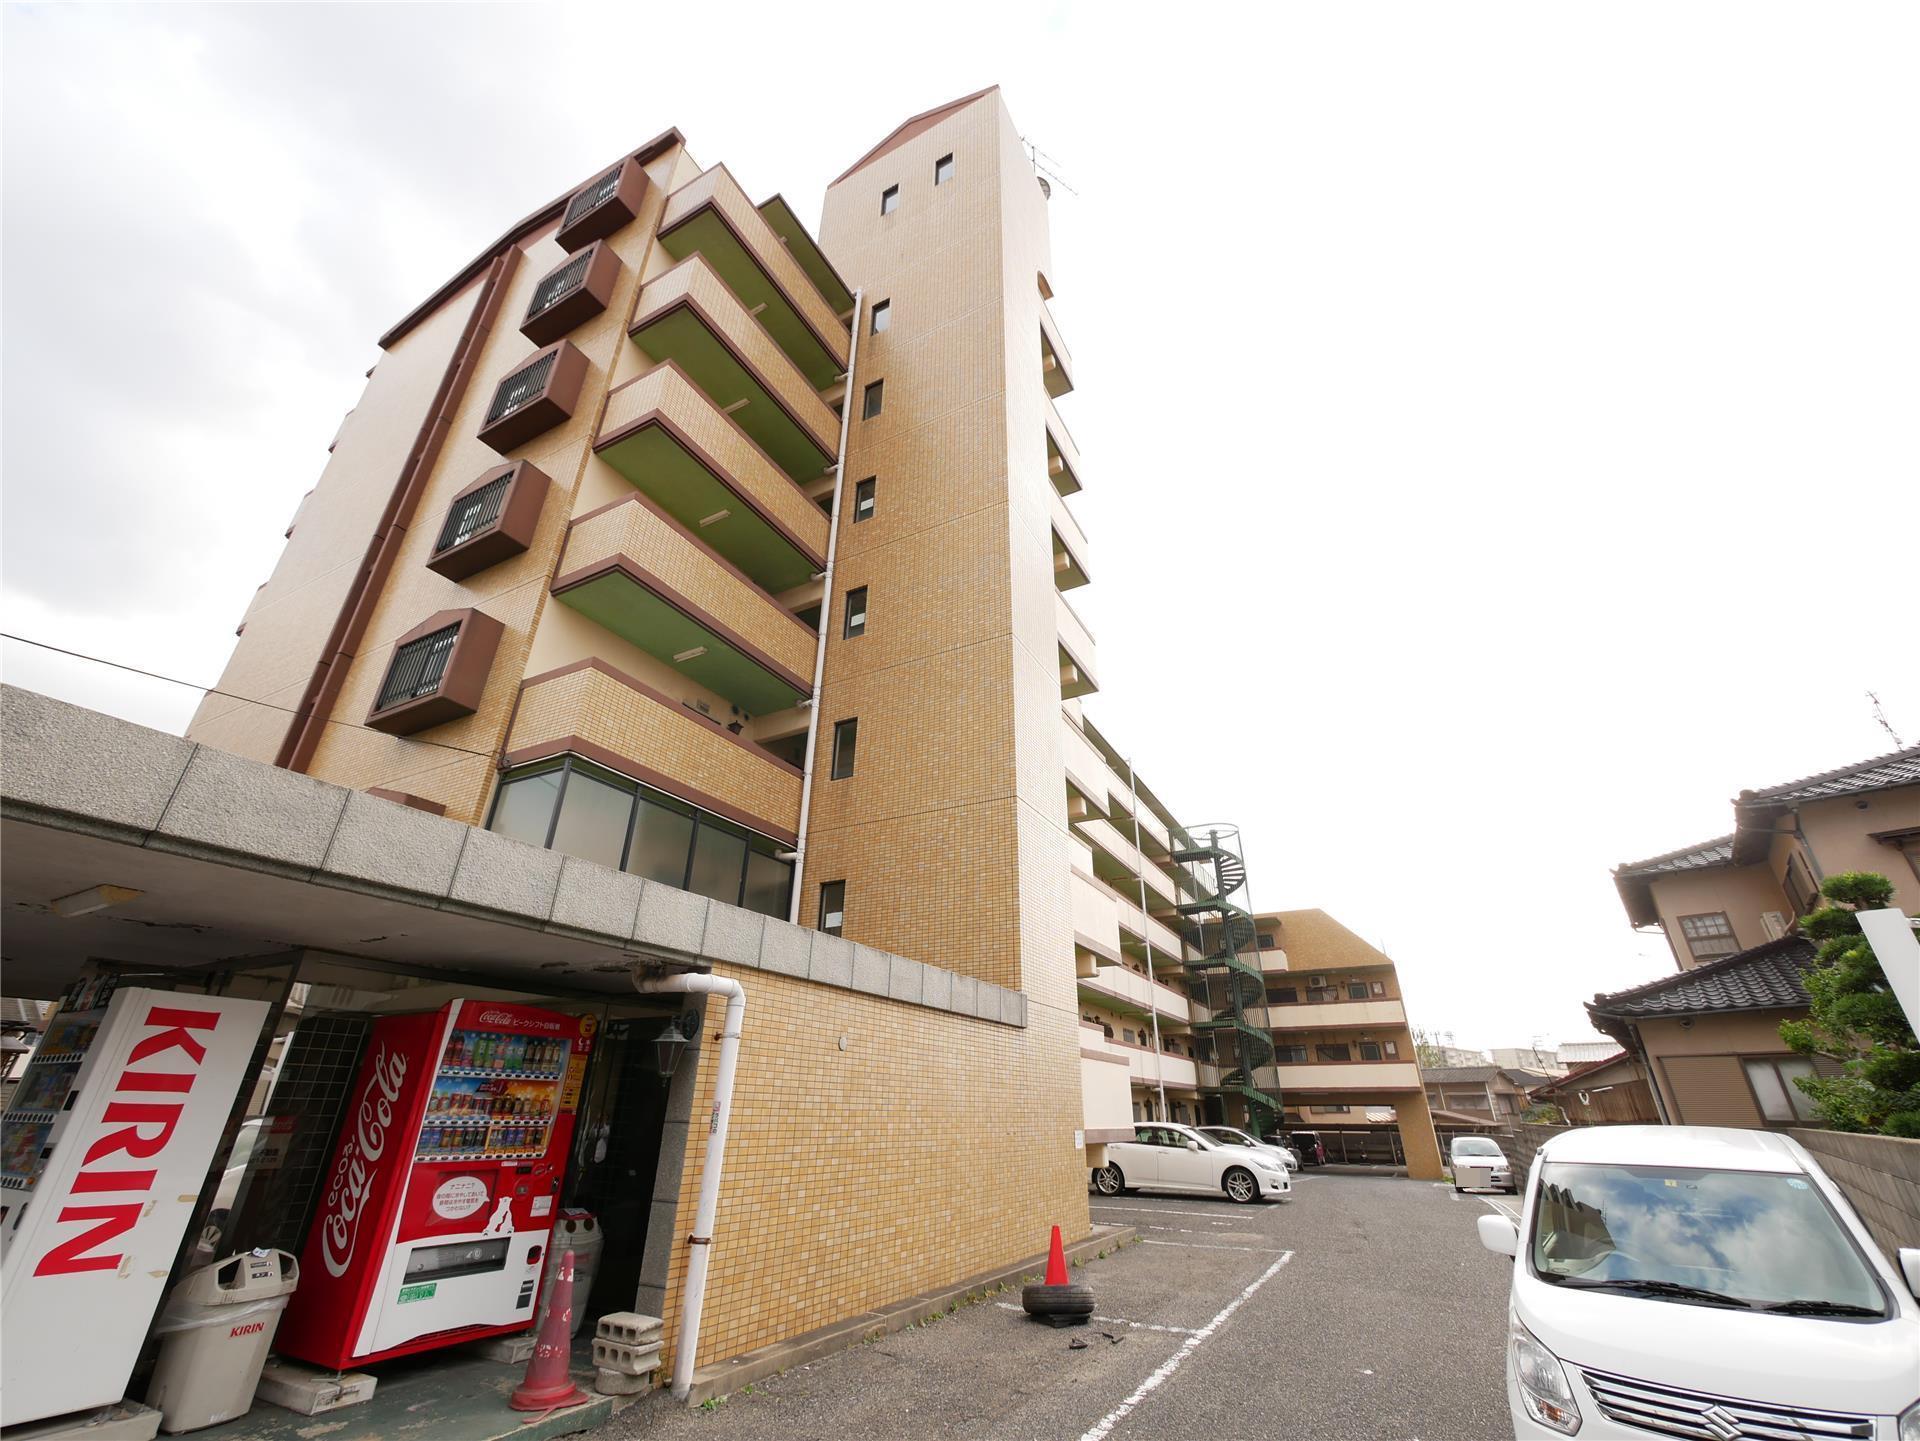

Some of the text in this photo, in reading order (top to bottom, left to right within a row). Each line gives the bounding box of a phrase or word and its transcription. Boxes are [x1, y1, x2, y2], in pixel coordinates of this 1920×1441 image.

[479, 1011, 512, 1025] Coca-Cola
[33, 1007, 221, 1277] KIRIN
[322, 1040, 407, 1278] Coca-Cola
[230, 1322, 265, 1337] KIRIN
